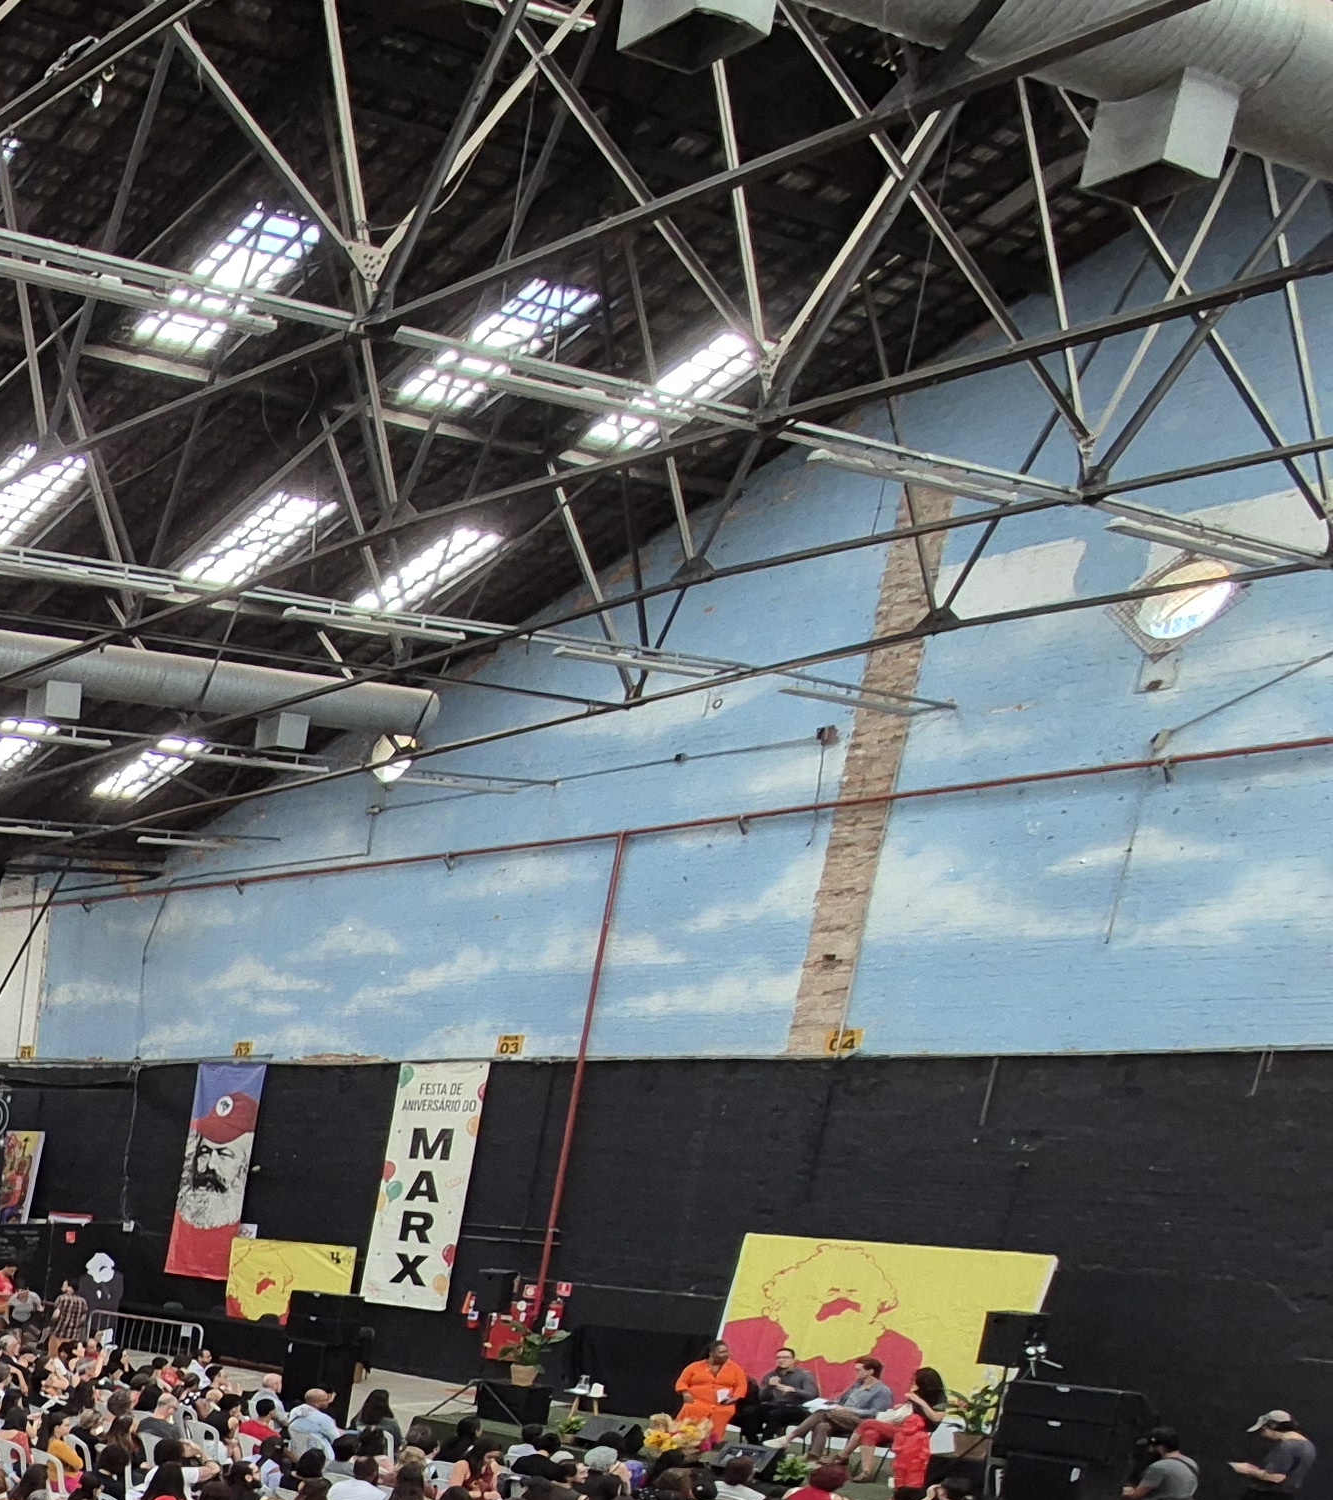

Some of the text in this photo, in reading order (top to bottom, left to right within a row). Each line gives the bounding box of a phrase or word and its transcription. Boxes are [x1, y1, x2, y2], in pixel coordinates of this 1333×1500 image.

[235, 1048, 251, 1057] 02
[499, 1042, 519, 1054] 03
[419, 1083, 463, 1096] FESTA DE
[402, 1097, 476, 1113] ANIVERSÁRIO DO
[389, 1127, 454, 1287] MARX
